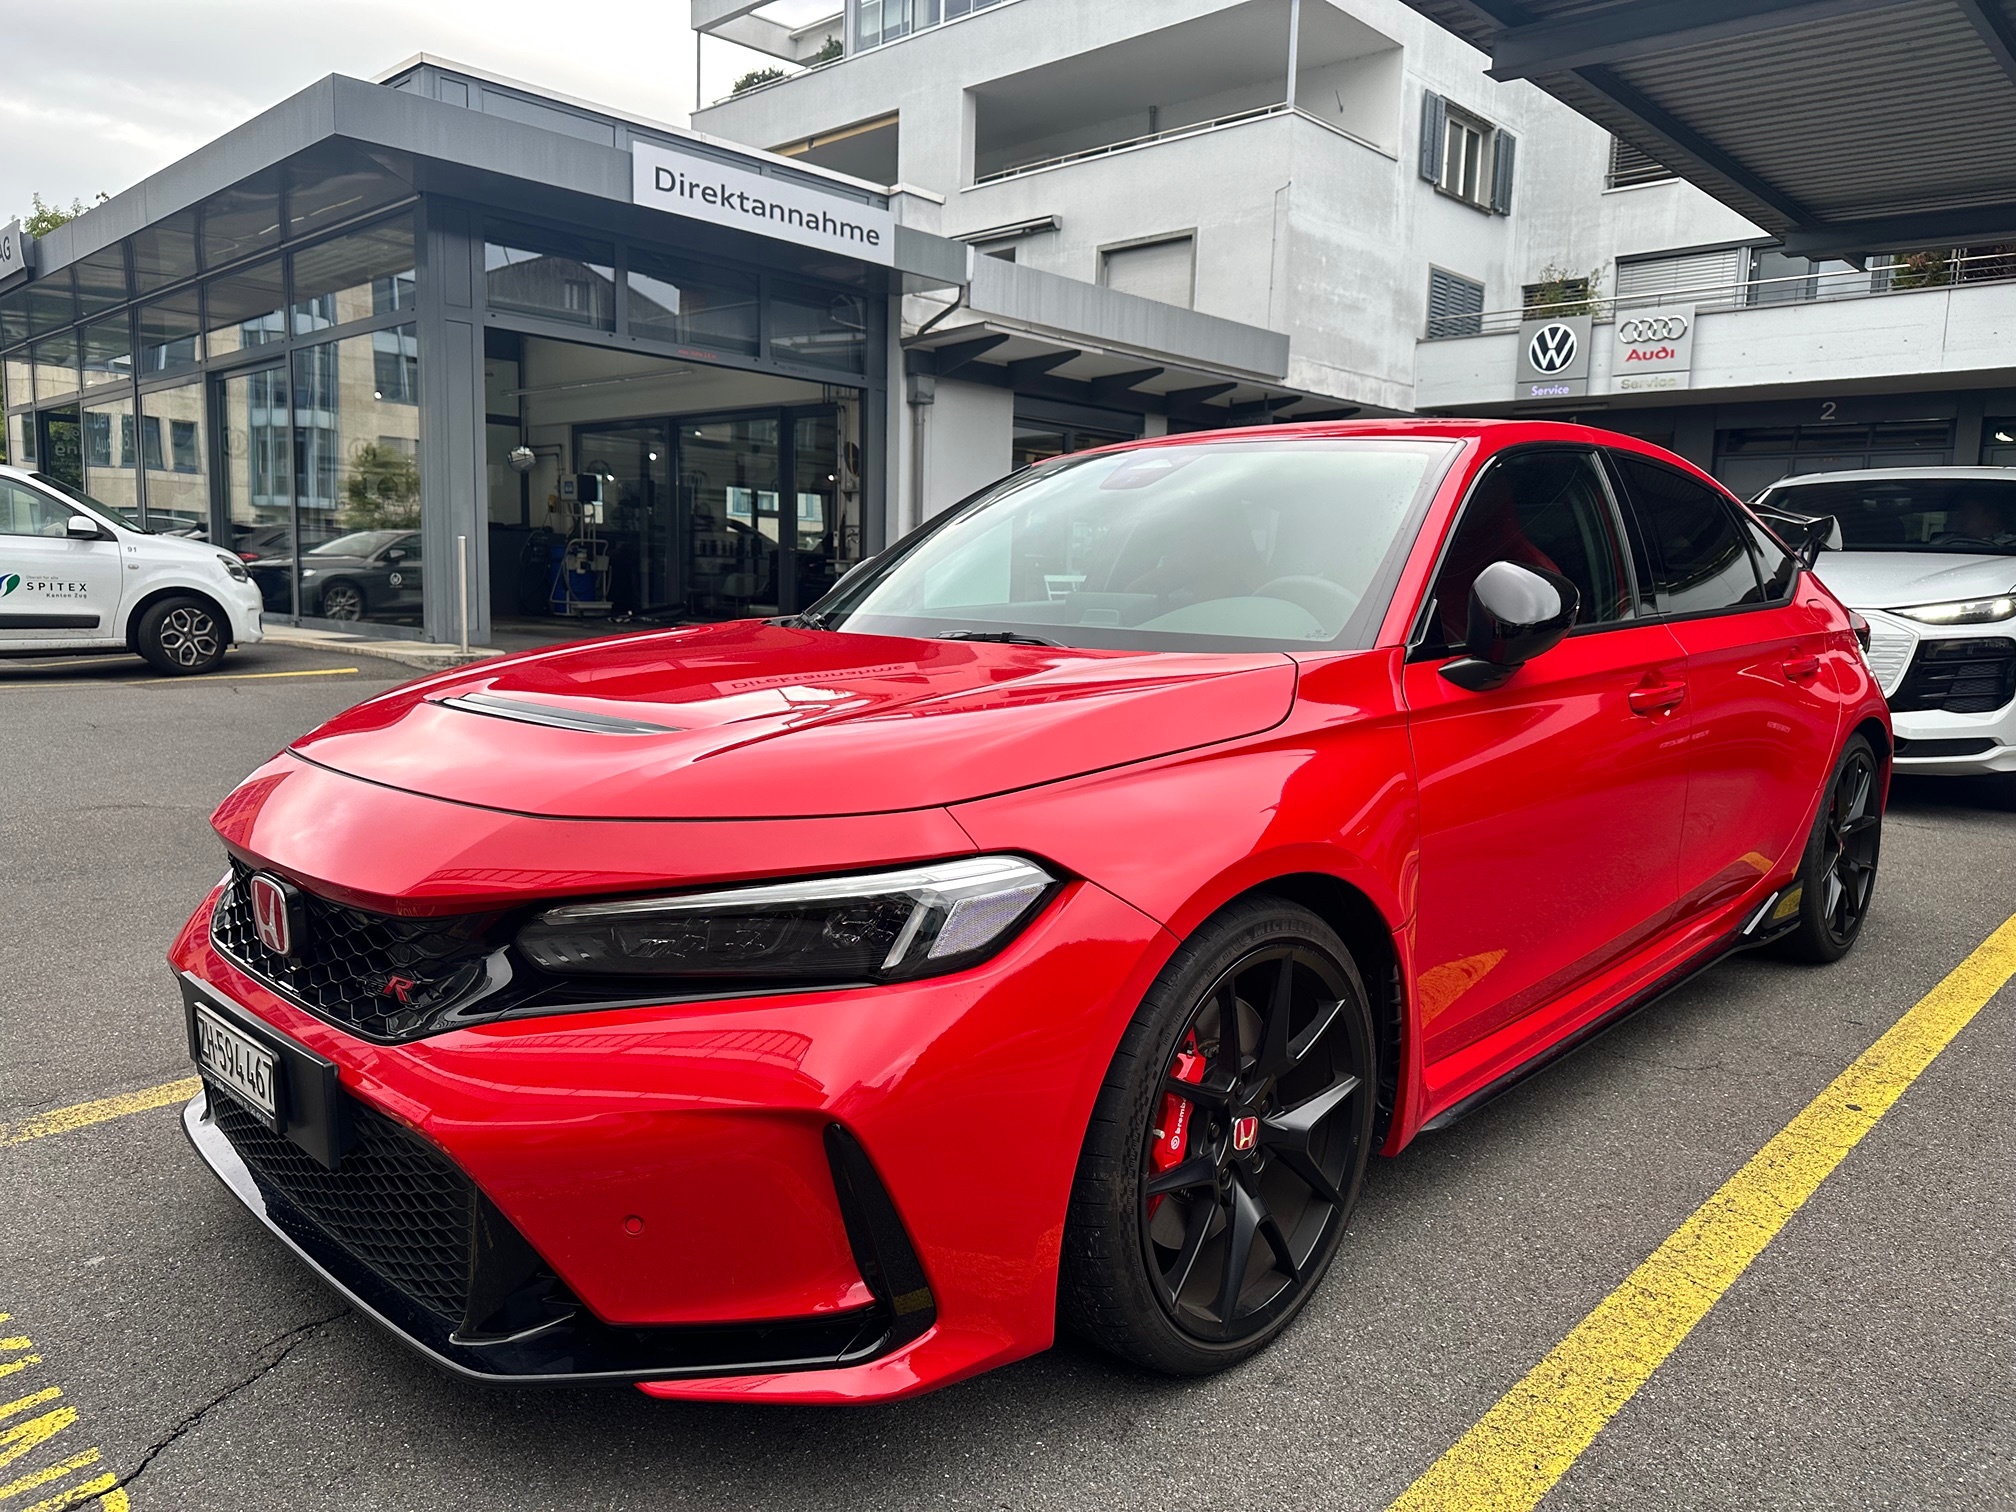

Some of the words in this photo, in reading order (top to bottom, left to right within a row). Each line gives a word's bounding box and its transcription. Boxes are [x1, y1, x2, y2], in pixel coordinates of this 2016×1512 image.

[654, 165, 880, 246] Direktannahme
[1625, 346, 1675, 362] Audi
[1531, 384, 1570, 397] Service
[1620, 376, 1677, 390] Service
[1820, 401, 1837, 420] 2
[26, 581, 87, 592] SPITEX
[1253, 919, 1321, 938] MICHEL
